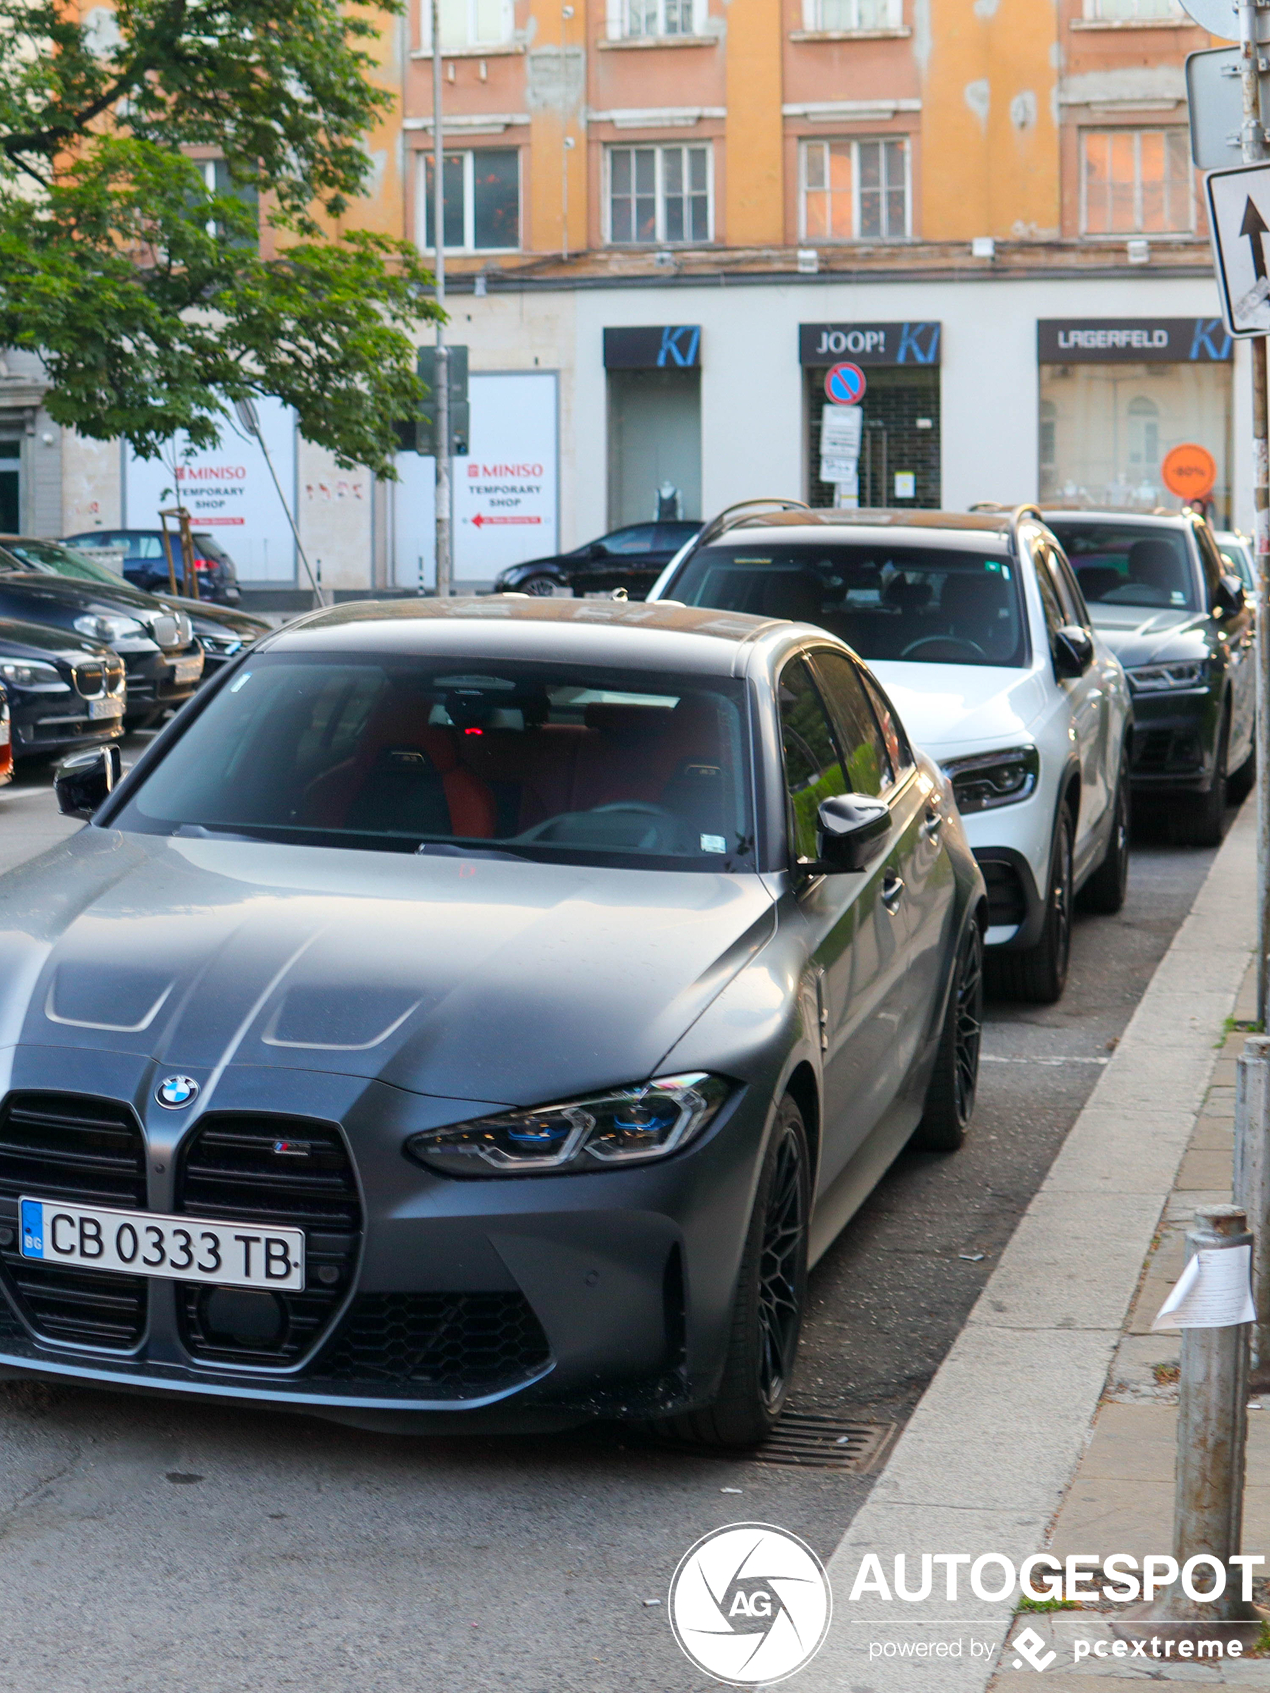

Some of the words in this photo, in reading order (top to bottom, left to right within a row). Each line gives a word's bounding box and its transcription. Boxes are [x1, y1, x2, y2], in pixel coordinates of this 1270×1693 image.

[816, 330, 886, 354] JOOP!
[1057, 329, 1169, 349] LAGERFELD
[188, 466, 246, 480] MINISO
[482, 463, 543, 477] MINISO
[469, 485, 541, 494] TEMPORARY
[195, 500, 225, 509] SHOP
[489, 498, 521, 507] SHOP
[24, 1235, 43, 1250] BG
[51, 1213, 104, 1259] CB
[115, 1222, 222, 1274] 0333
[234, 1234, 292, 1280] TB
